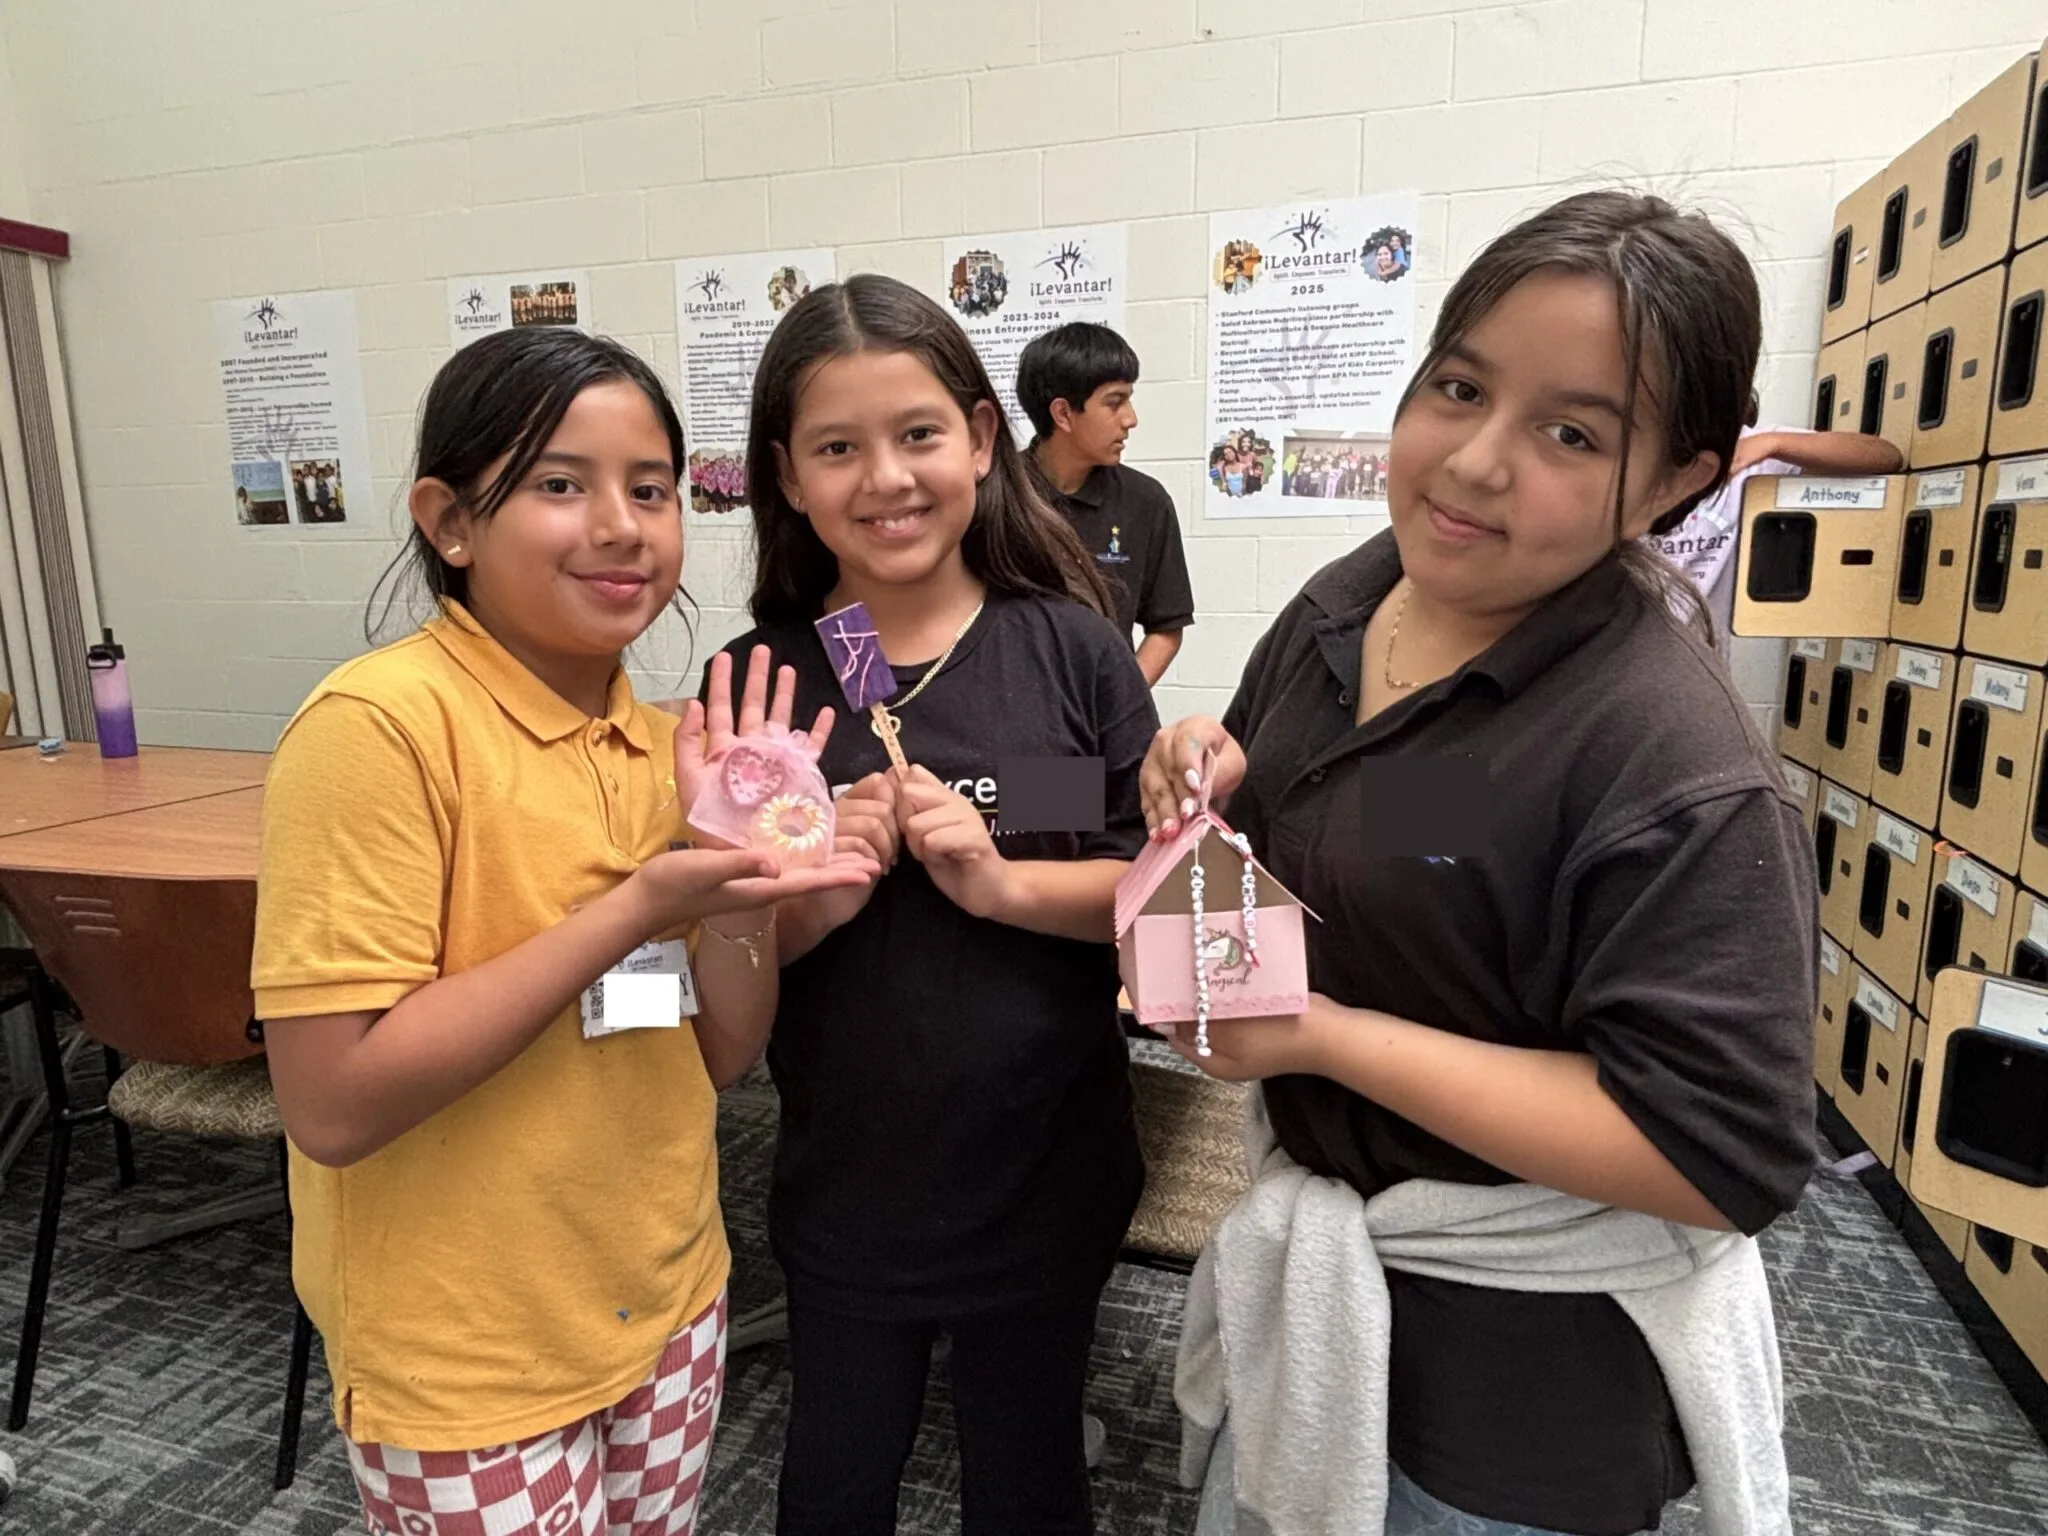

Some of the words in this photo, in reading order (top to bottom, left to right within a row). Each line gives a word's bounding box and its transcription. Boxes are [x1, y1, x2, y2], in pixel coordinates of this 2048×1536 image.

[1264, 248, 1357, 270] ¡Levantar!
[1030, 277, 1112, 297] ¡Levantar!
[1290, 284, 1325, 296] 2025
[684, 299, 746, 314] ¡Levantar!
[1221, 309, 1253, 317] Stanford
[1255, 306, 1296, 315] Community
[1298, 304, 1331, 312] listening
[1333, 302, 1359, 311] groups
[455, 312, 501, 325] ¡Levantar!
[1002, 311, 1060, 322] 2023-2024
[1329, 310, 1375, 321] partnership
[1376, 309, 1394, 317] with
[1269, 325, 1301, 334] Institute
[1341, 320, 1384, 329] Healthcare
[244, 327, 298, 343] ¡Levantar!
[700, 331, 736, 339] Pandemic
[1220, 348, 1247, 357] Beyond
[1259, 346, 1285, 354] Mental
[1285, 344, 1310, 353] Health
[1341, 340, 1386, 350] partnership
[1388, 338, 1406, 346] with
[1349, 350, 1367, 358] KIPP
[238, 355, 266, 365] Founded
[267, 355, 280, 363] and
[280, 351, 328, 361] Incorporated
[1219, 368, 1256, 376] Carpentry
[1286, 364, 1303, 372] with
[1338, 361, 1346, 369] of
[1365, 358, 1405, 368] Carpentry
[1219, 378, 1262, 386] Partnership
[1331, 371, 1347, 379] EPA
[1348, 370, 1360, 378] for
[1361, 369, 1393, 378] Summer
[1240, 396, 1267, 405] Change
[1319, 391, 1350, 400] updated
[1351, 390, 1382, 398] mission
[1259, 404, 1274, 412] and
[1801, 486, 1860, 504] Anthony
